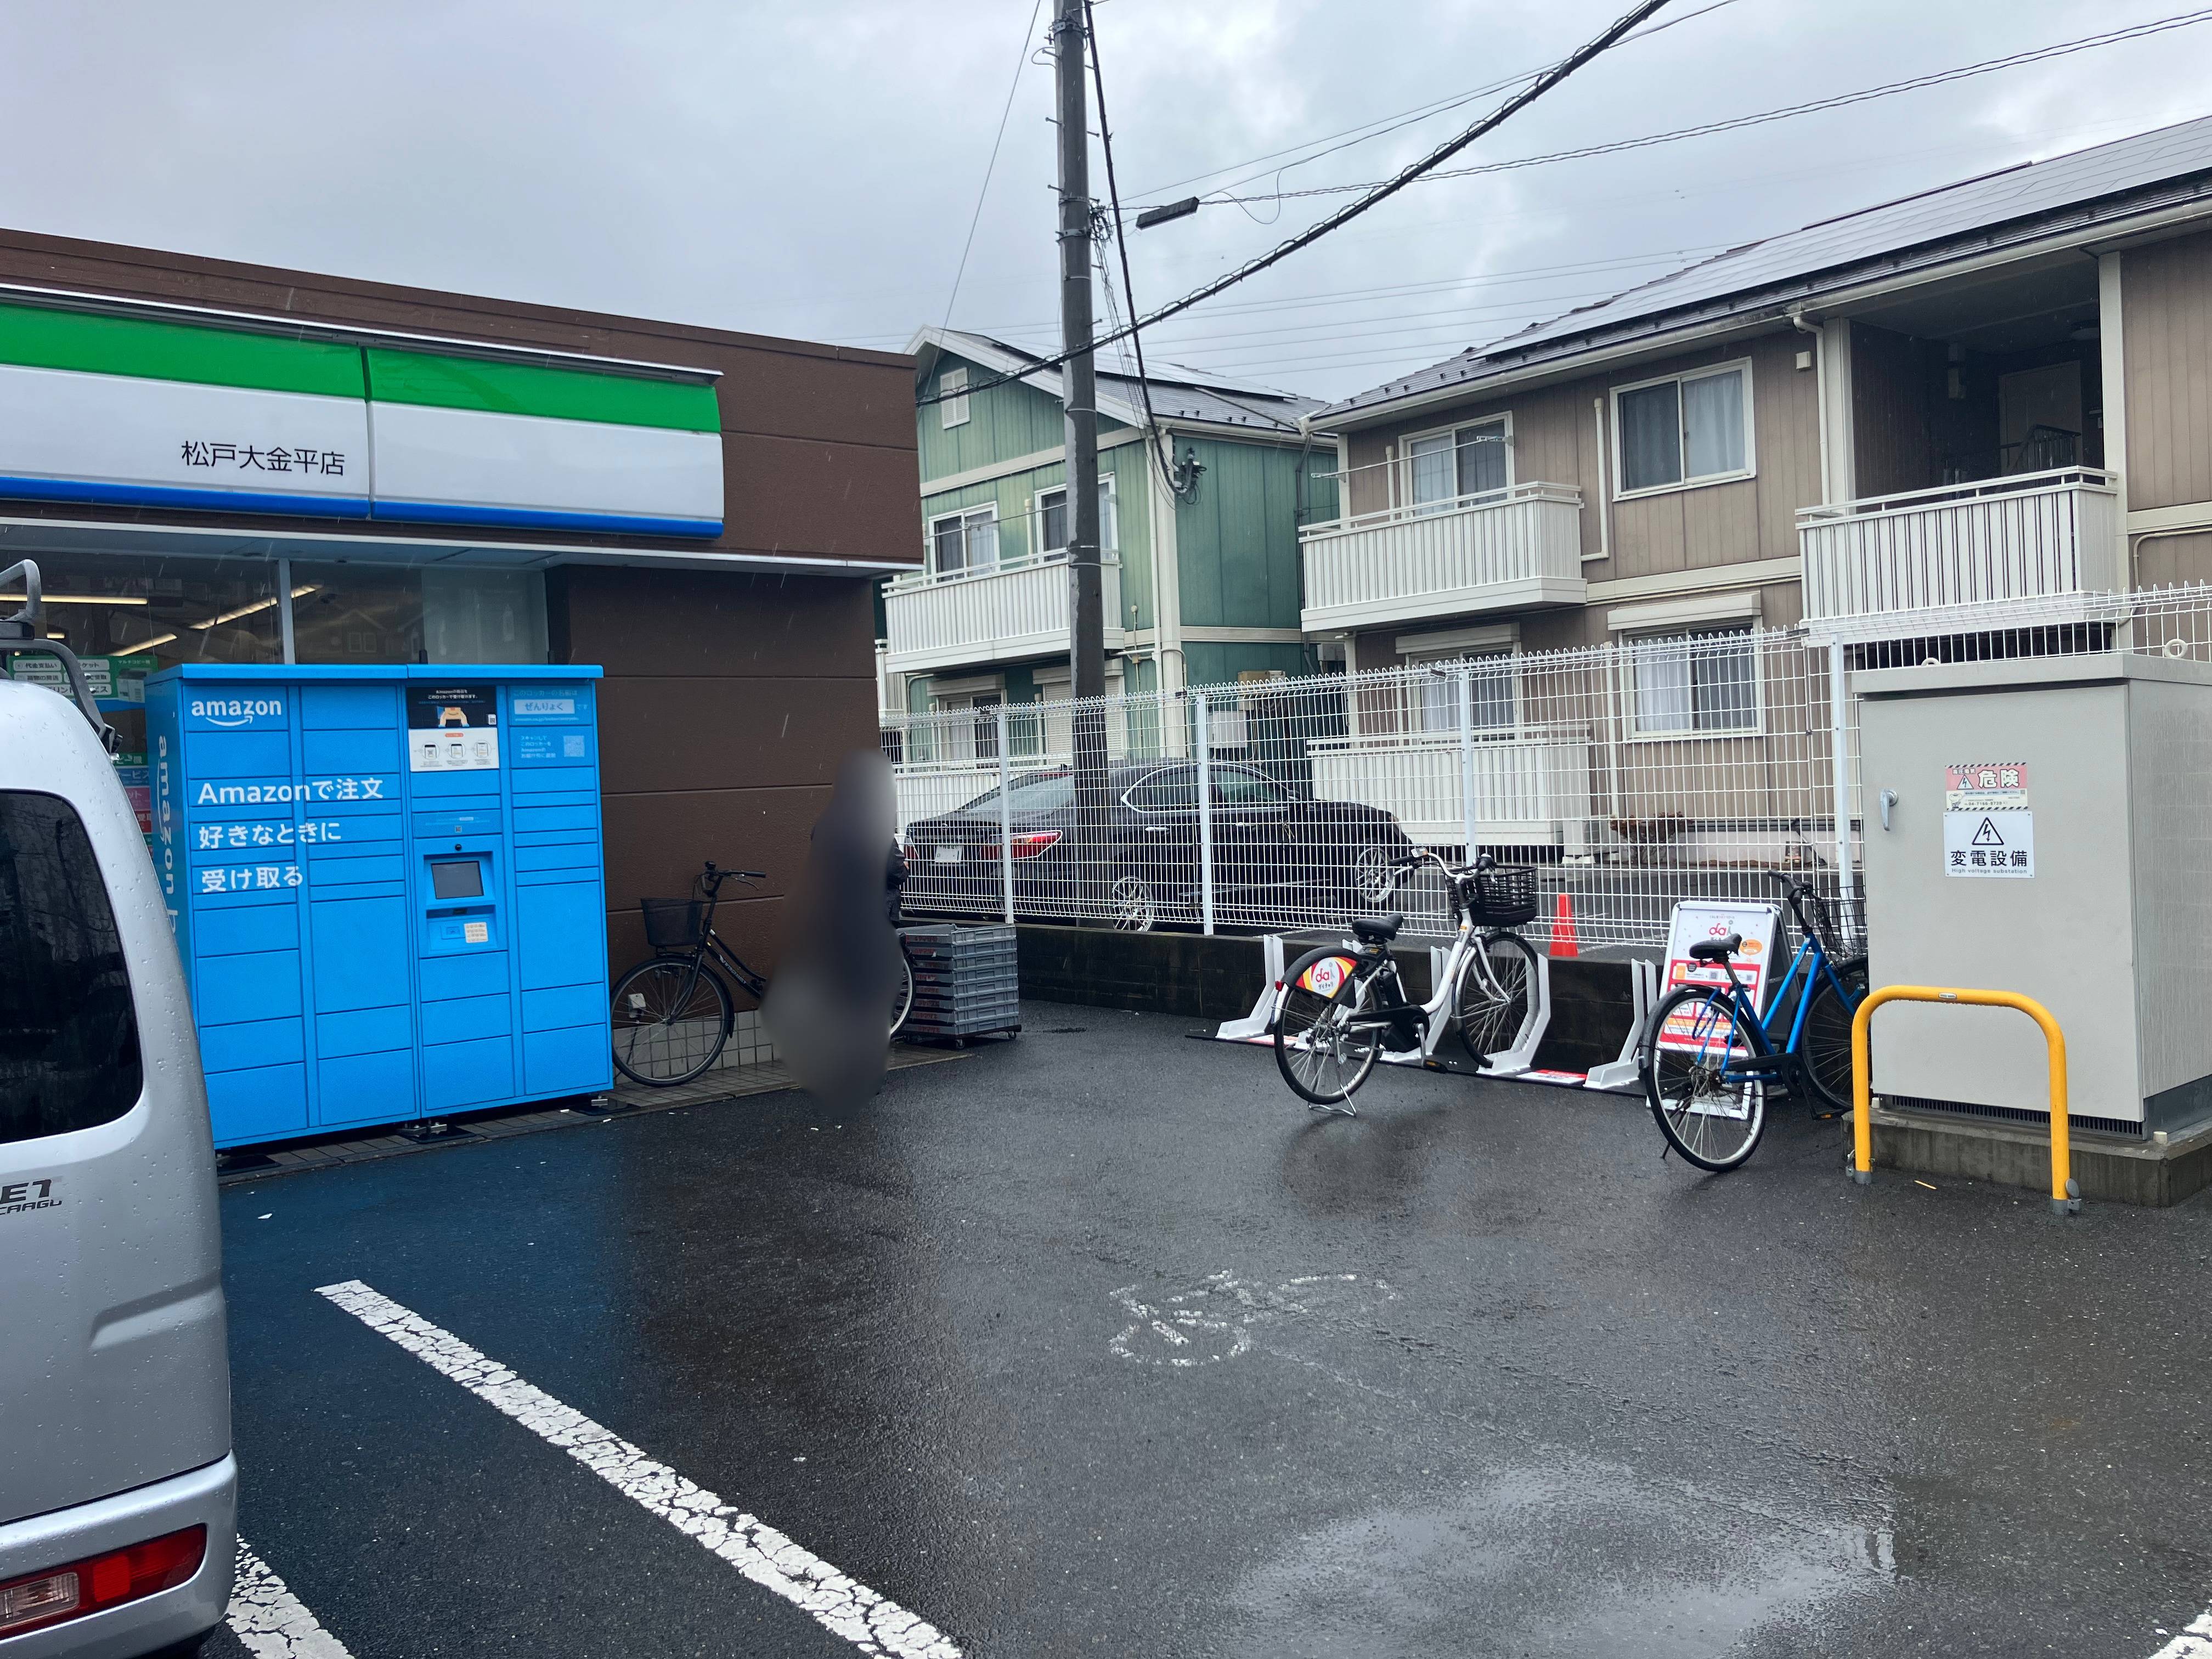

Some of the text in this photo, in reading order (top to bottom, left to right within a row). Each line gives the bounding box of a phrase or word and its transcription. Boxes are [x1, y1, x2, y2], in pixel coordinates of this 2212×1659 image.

[181, 441, 345, 476] 松戸大金平店
[191, 699, 281, 718] amazon
[524, 702, 563, 711] ぜんりょく
[198, 777, 383, 804] Amazonで注文
[1977, 769, 2019, 788] 危険
[159, 736, 174, 895] amazon
[199, 822, 341, 849] 好きなときに
[1950, 850, 2027, 867] 変電設備
[201, 865, 303, 893] 受け取る
